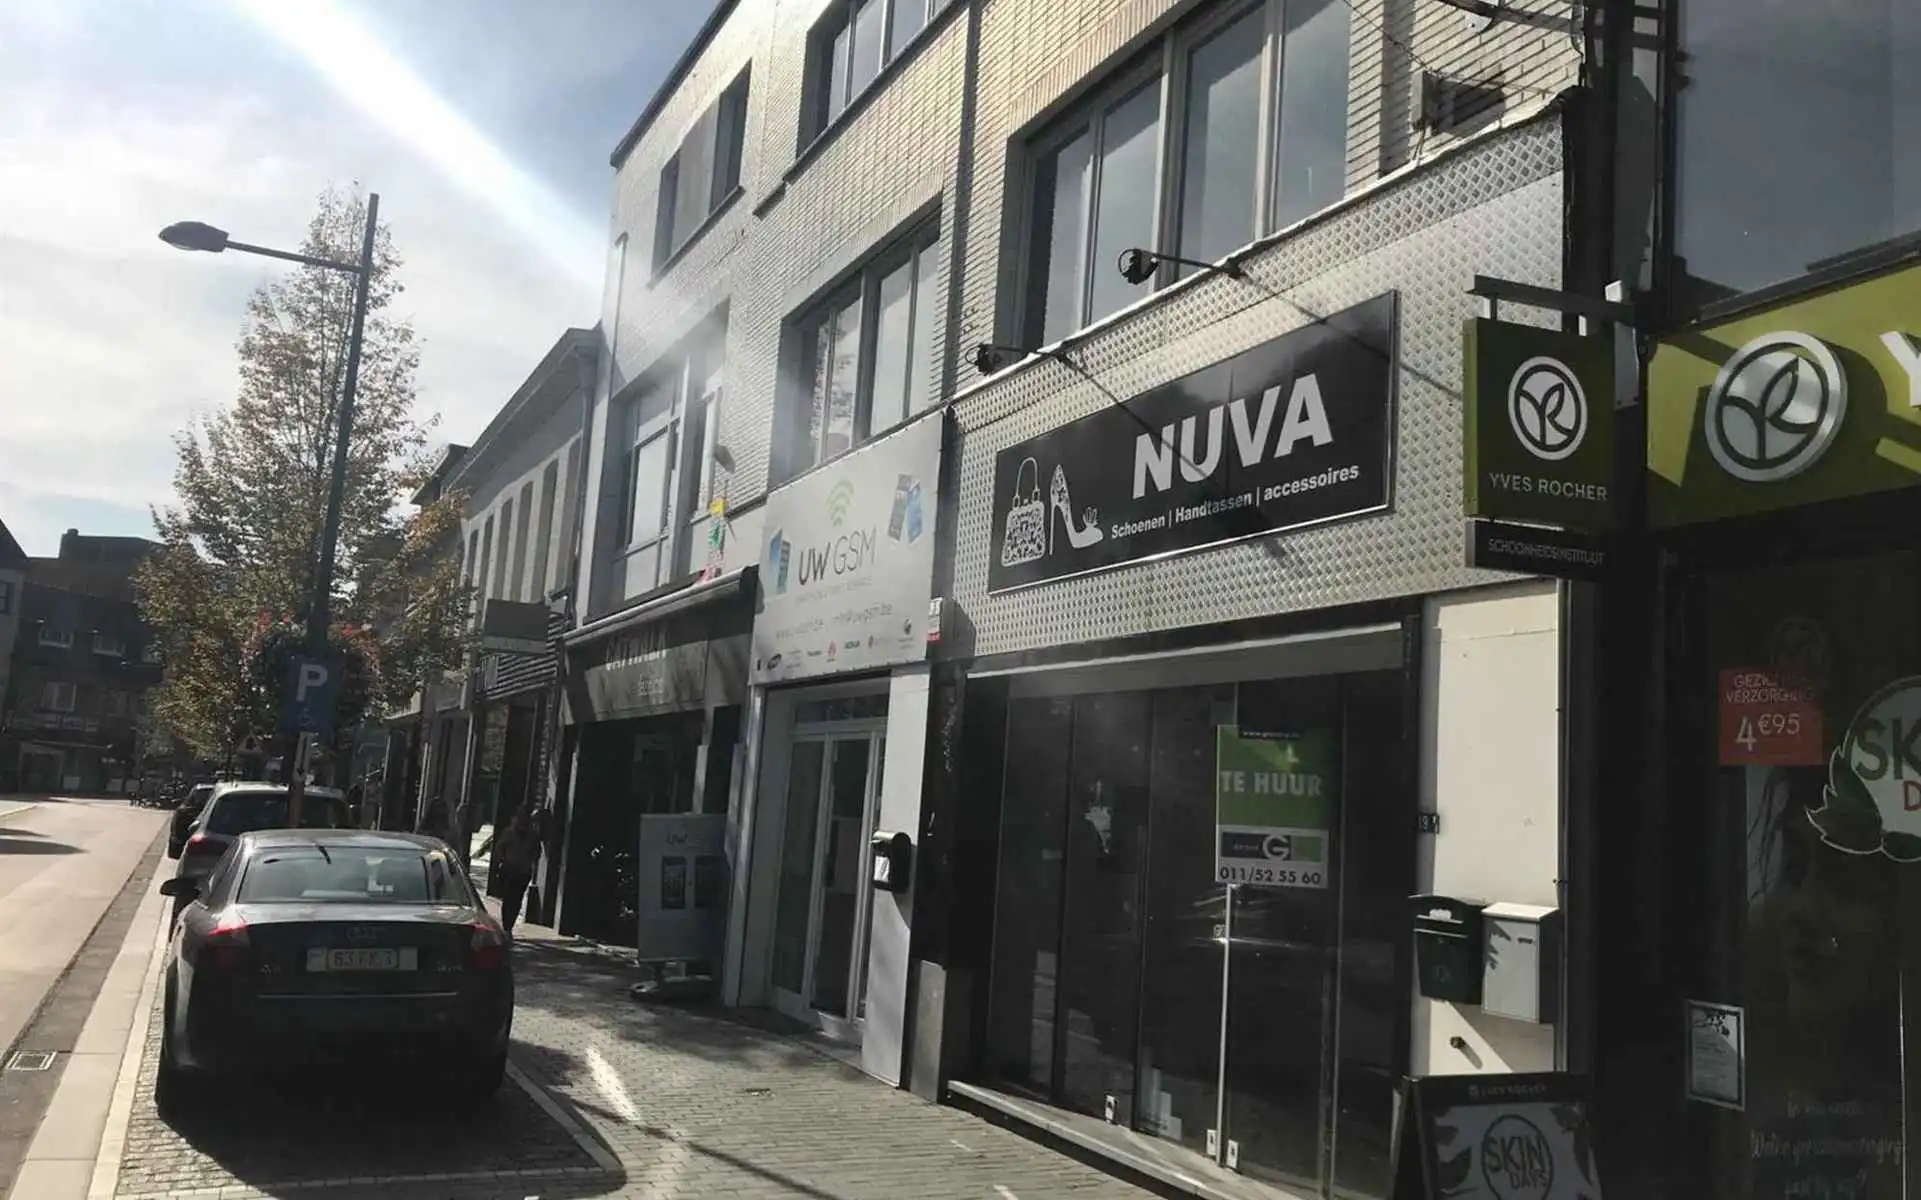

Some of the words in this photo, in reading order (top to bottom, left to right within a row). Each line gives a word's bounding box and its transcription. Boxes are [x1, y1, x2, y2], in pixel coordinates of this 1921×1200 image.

[1132, 373, 1334, 499] NUVA
[1111, 514, 1166, 539] Schoenen
[1175, 493, 1252, 523] Handtassen
[1264, 463, 1359, 500] accessoires
[1488, 472, 1533, 493] YVES
[1538, 478, 1608, 502] ROCHER
[799, 543, 831, 587] UW
[832, 527, 878, 575] GSM
[296, 663, 329, 702] P
[1219, 770, 1246, 793] TE
[1254, 772, 1324, 797] HUUR
[1220, 867, 1273, 884] 011/52
[1278, 870, 1296, 883] 55
[1302, 872, 1321, 885] 60
[1484, 1134, 1546, 1175] SKIN
[1509, 1168, 1548, 1191] DAYS
